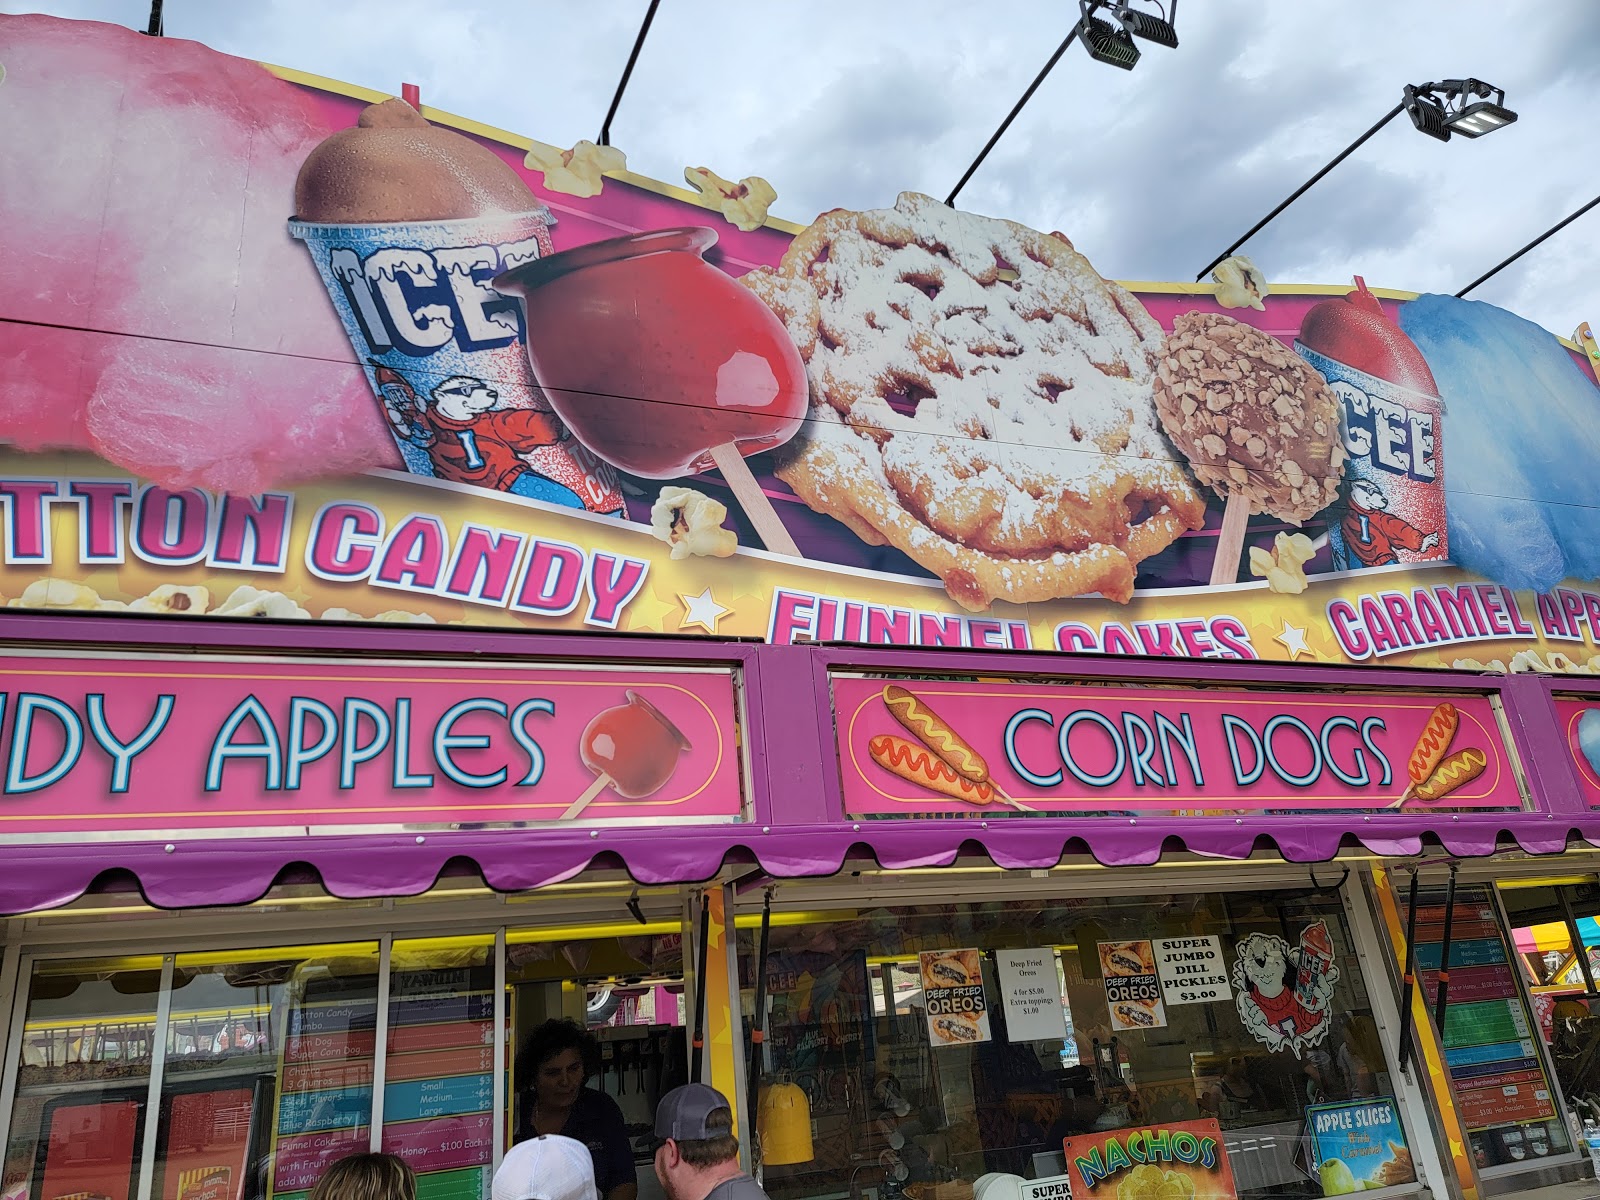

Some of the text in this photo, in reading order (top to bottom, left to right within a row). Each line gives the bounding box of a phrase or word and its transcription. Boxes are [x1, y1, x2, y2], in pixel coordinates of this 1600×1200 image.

[304, 500, 651, 629] CANDY
[1325, 583, 1537, 661] CARAMEL
[0, 692, 556, 795] DY APPLES
[1003, 708, 1393, 787] CORN DOGS
[1162, 938, 1212, 950] SUPER
[1163, 950, 1216, 963] JUMBO
[1010, 959, 1043, 969] Deep Fried
[1175, 964, 1210, 975] DILL
[1106, 976, 1155, 987] DEEP FRIED
[1163, 975, 1227, 989] PICKLES
[926, 986, 982, 999] DEEP FRIED
[1107, 985, 1158, 1001] OREOS
[1180, 990, 1217, 1001] $3.00
[927, 997, 984, 1014] OREOS
[1028, 997, 1054, 1007] toppings
[293, 1010, 324, 1021] Cotton
[326, 1007, 353, 1018] Candy
[1023, 1007, 1040, 1015] $1.00
[292, 1022, 323, 1032] Jumbo
[291, 1038, 313, 1048] Corn
[315, 1037, 333, 1047] Dog
[835, 1032, 863, 1045] CHERRY
[290, 1046, 361, 1060] Super Corn Dog
[288, 1066, 321, 1077] Churro
[288, 1080, 294, 1089] 3
[296, 1077, 333, 1088] Churros
[420, 1080, 444, 1092] Small
[420, 1094, 453, 1105] Medium
[1503, 1104, 1526, 1112] Chocolate
[283, 1120, 303, 1131] Blue
[305, 1115, 353, 1128] Raspberry
[419, 1107, 444, 1118] Large
[1316, 1105, 1392, 1134] APPLE SLICES
[281, 1139, 311, 1152] Funnel
[314, 1138, 337, 1147] Cake
[401, 1146, 429, 1158] Honey
[464, 1138, 483, 1149] Each
[1341, 1142, 1384, 1159] Caramel
[279, 1162, 300, 1173] with
[302, 1158, 327, 1169] Fruit
[1074, 1129, 1217, 1189] NACHOS
[278, 1177, 296, 1187] add
[1032, 1183, 1071, 1199] SUPER
